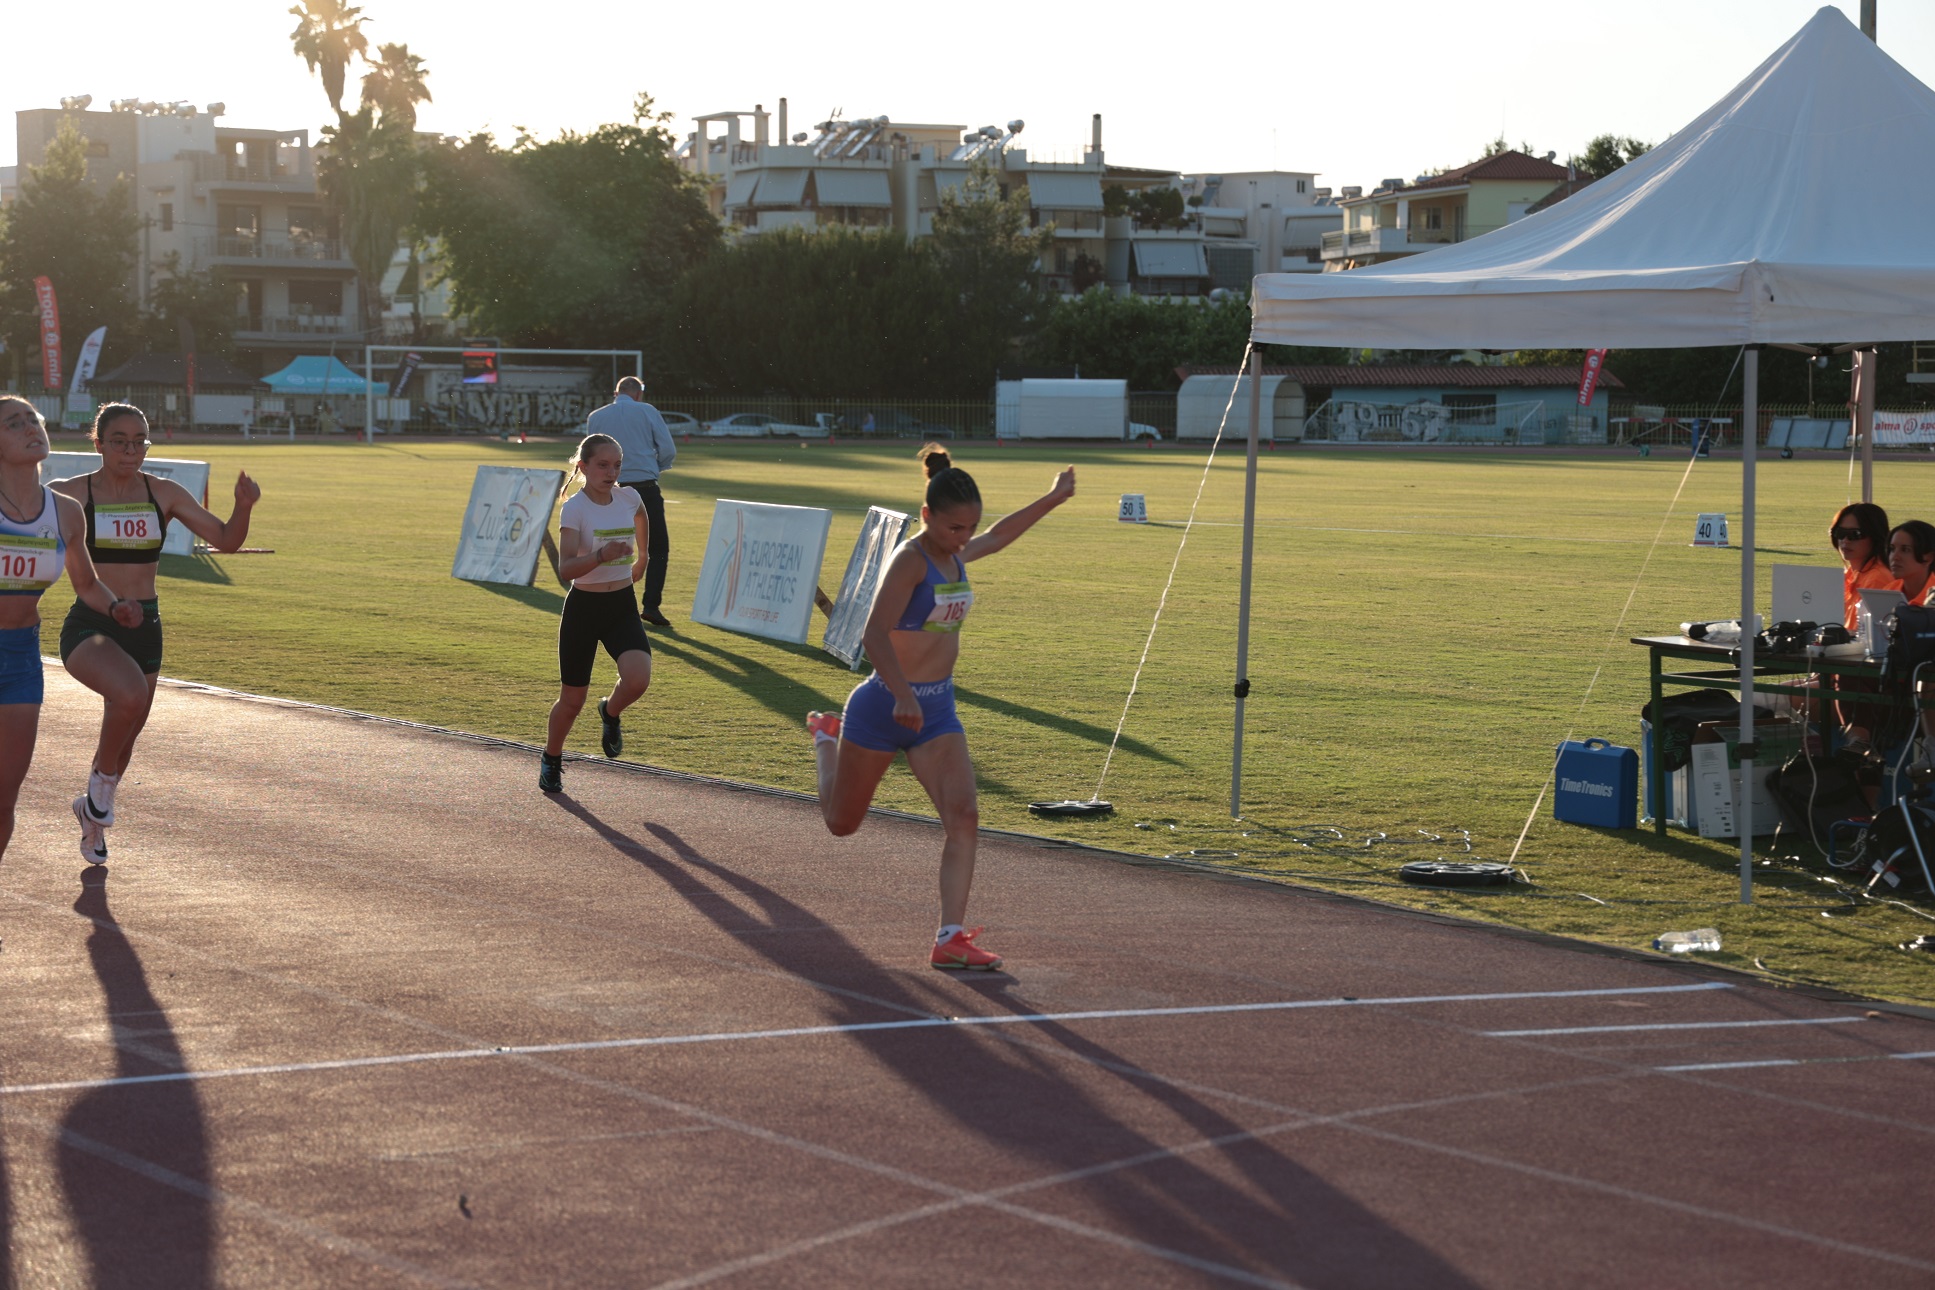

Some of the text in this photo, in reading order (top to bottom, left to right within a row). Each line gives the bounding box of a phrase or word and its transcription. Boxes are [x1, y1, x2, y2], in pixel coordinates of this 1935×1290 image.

[1579, 370, 1595, 404] alma
[1874, 421, 1901, 431] alma
[1920, 422, 1935, 431] spo
[1122, 502, 1134, 516] 50
[112, 519, 147, 538] 108
[1698, 522, 1712, 538] 40
[1, 555, 37, 578] 101
[748, 540, 804, 572] EUROPEAN
[742, 571, 798, 605] ATHLETICS
[943, 600, 966, 621] 105
[911, 681, 946, 697] NIKE
[1560, 777, 1614, 798] TimeTronics
